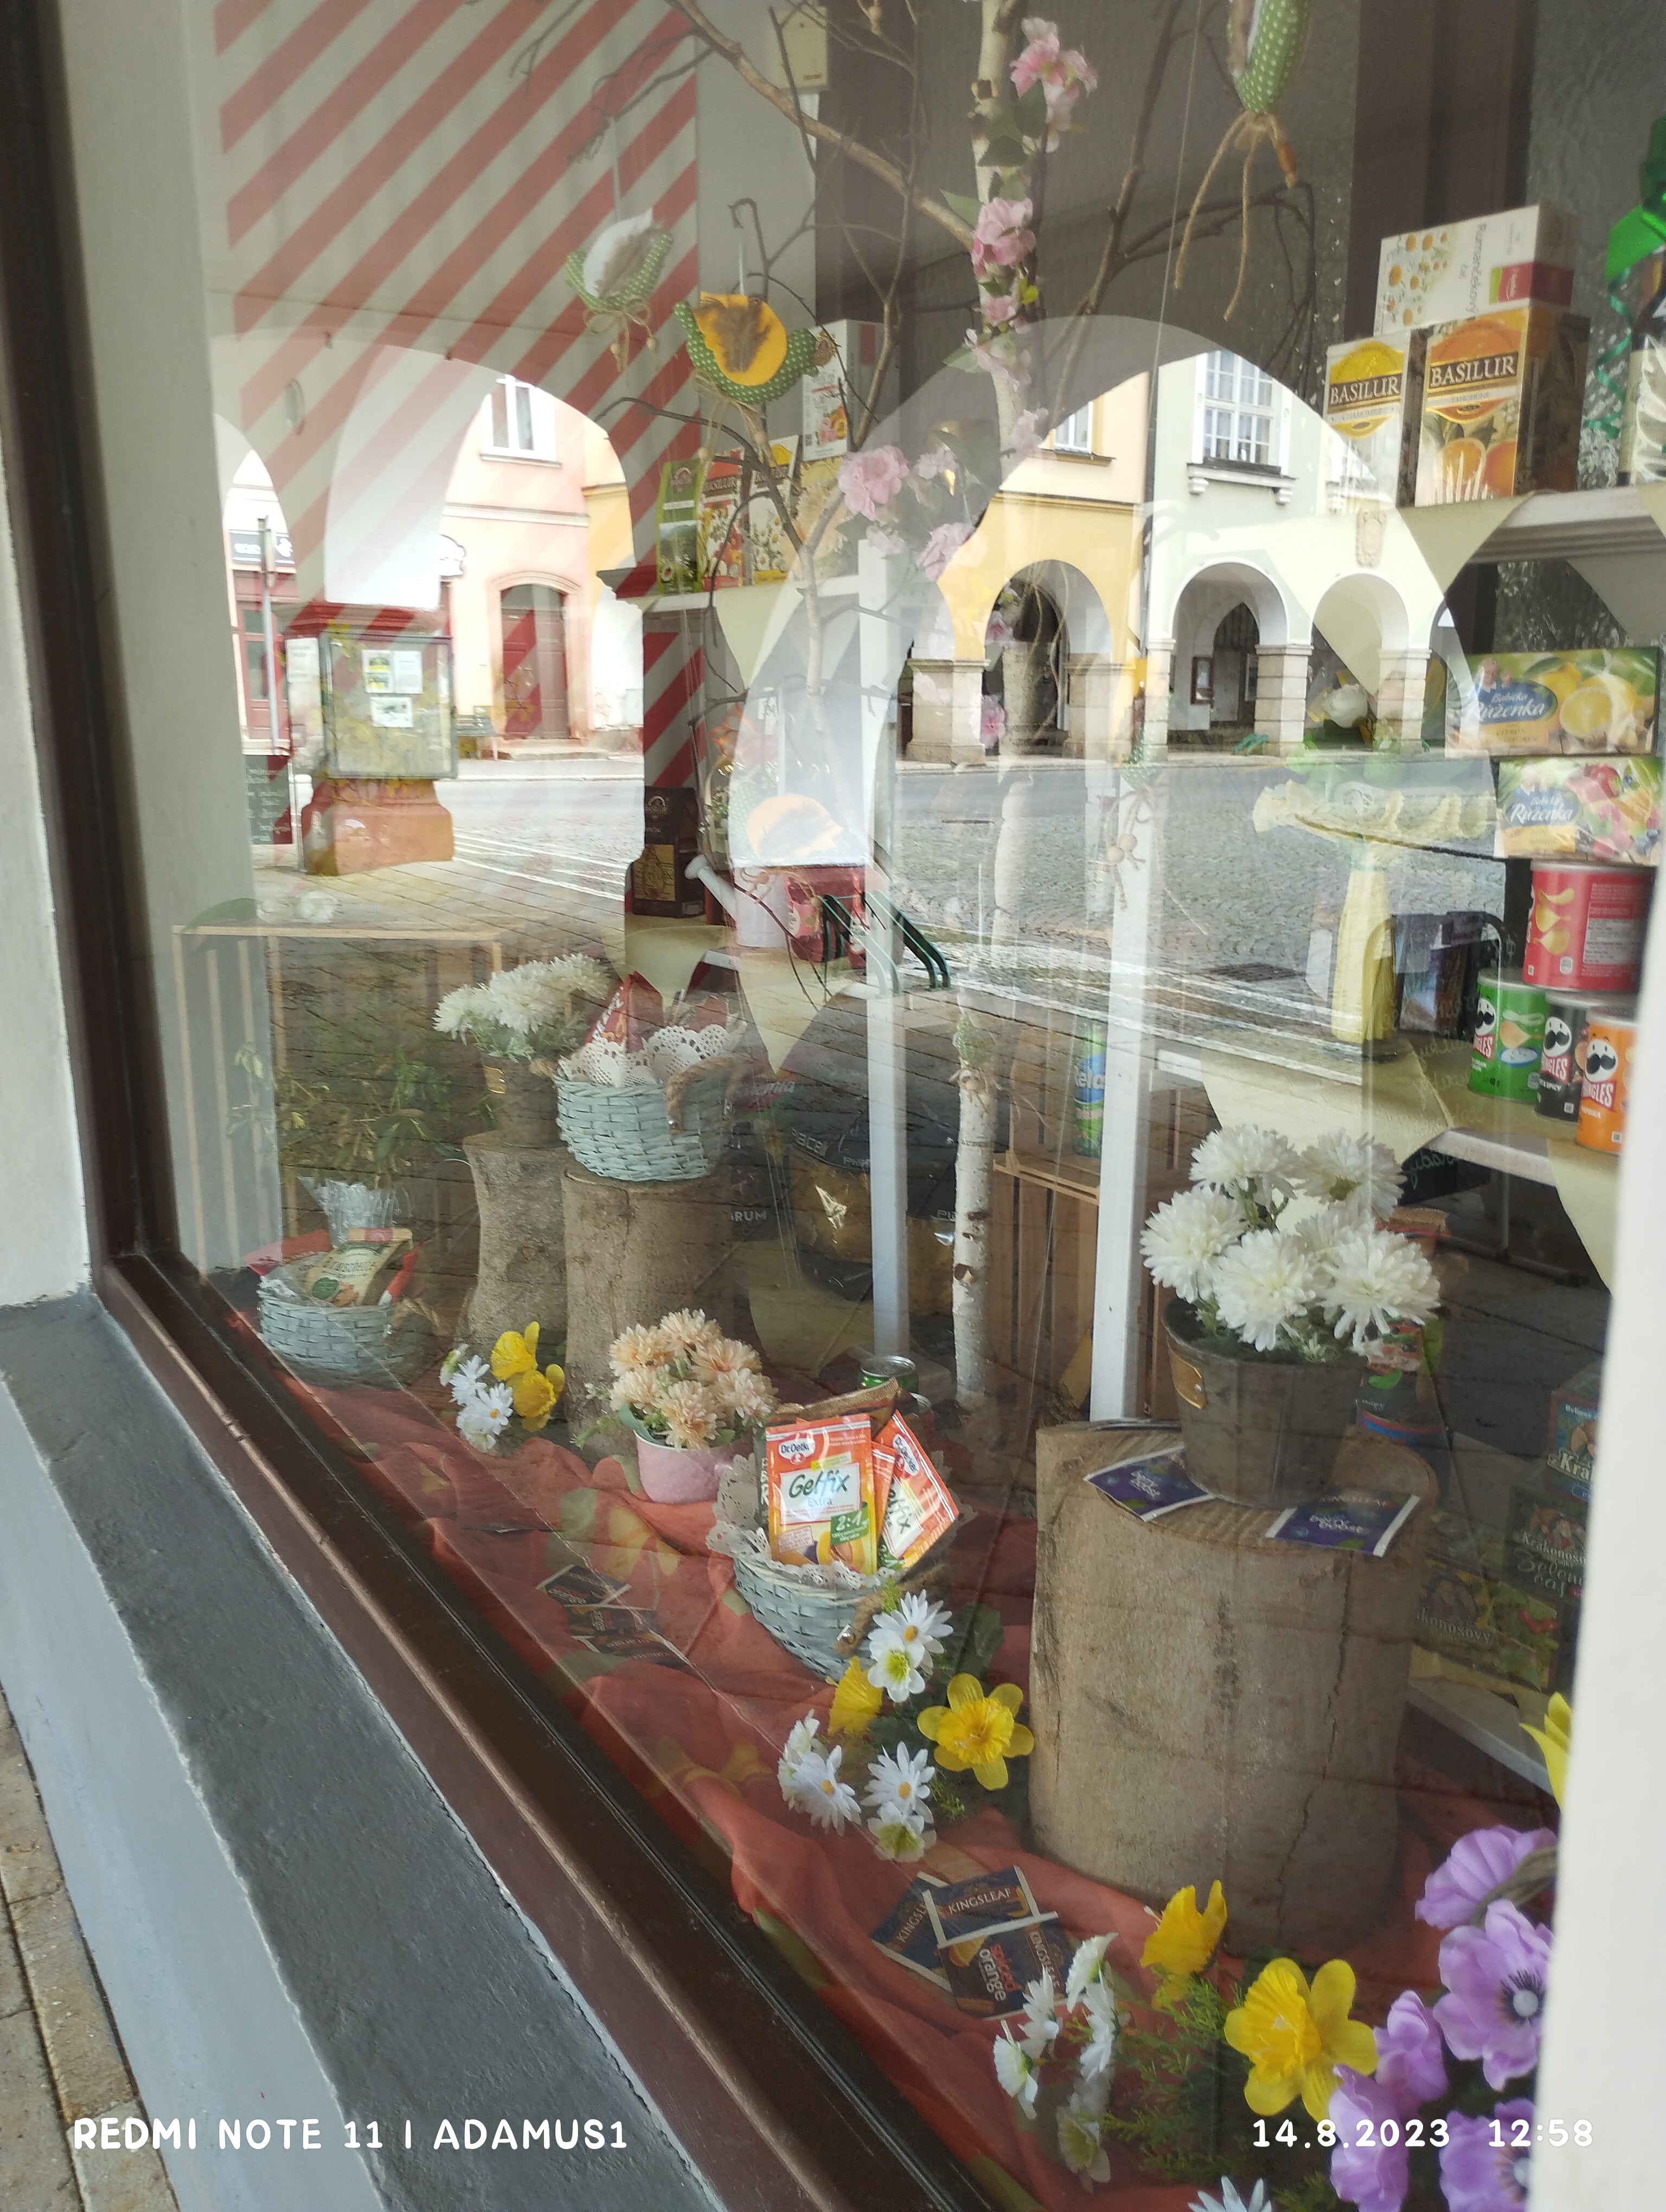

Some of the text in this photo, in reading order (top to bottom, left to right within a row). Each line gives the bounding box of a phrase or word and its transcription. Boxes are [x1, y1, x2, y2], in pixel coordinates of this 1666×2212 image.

[1430, 355, 1516, 388] BASILUR
[1330, 375, 1400, 406] BASILUR
[789, 1469, 851, 1499] Gelfix
[836, 1509, 863, 1532] 2:1
[947, 1887, 1013, 1915] KINGSLEAF
[896, 1901, 927, 1943] KINGSL
[978, 1949, 1007, 2002] orange
